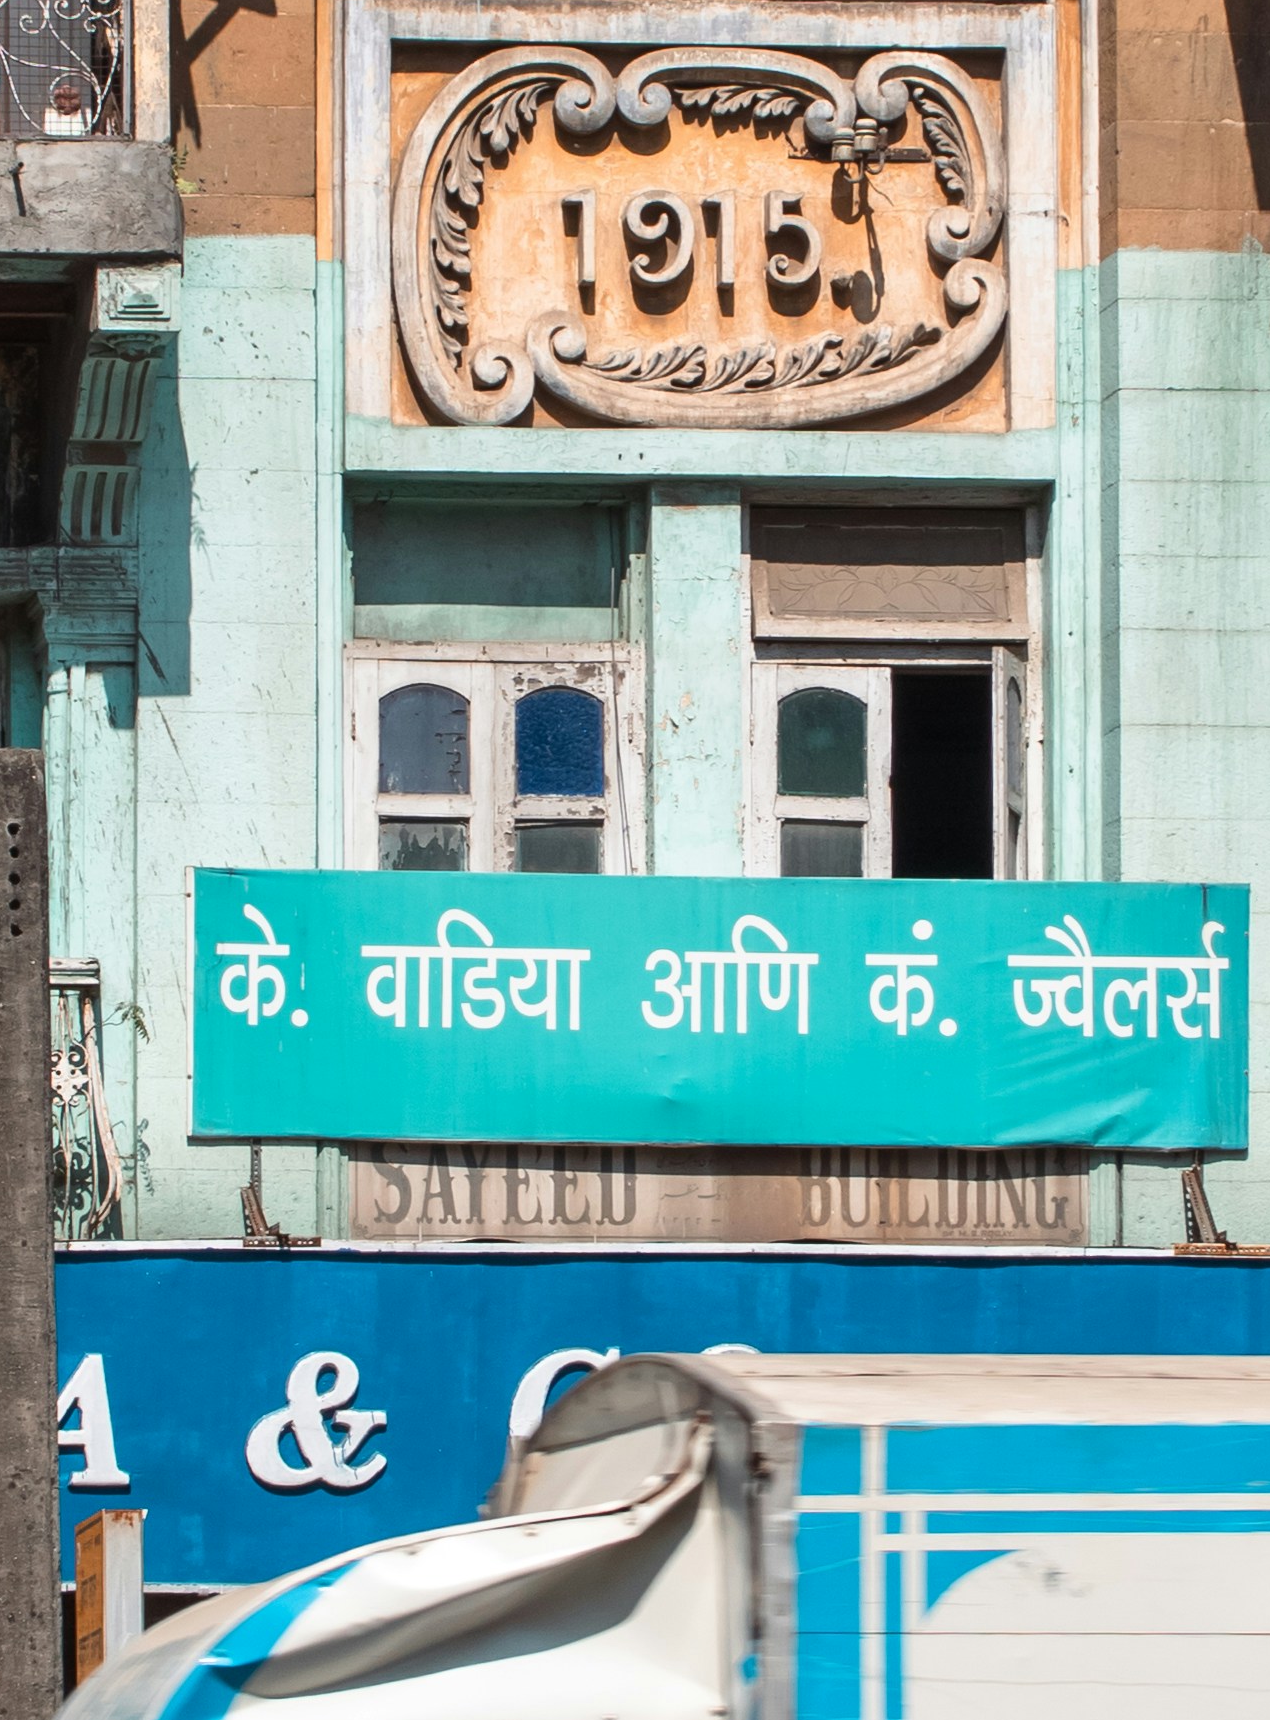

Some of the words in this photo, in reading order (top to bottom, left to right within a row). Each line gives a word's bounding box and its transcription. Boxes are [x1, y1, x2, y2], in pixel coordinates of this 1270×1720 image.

[215, 903, 310, 1028] के.
[361, 908, 591, 1031] वाडिया
[641, 914, 819, 1035] आणि
[865, 919, 959, 1037] कं.
[1007, 914, 1229, 1039] ज्वैलर्स
[796, 1146, 1069, 1229] BUILDING
[245, 1350, 388, 1489] &
